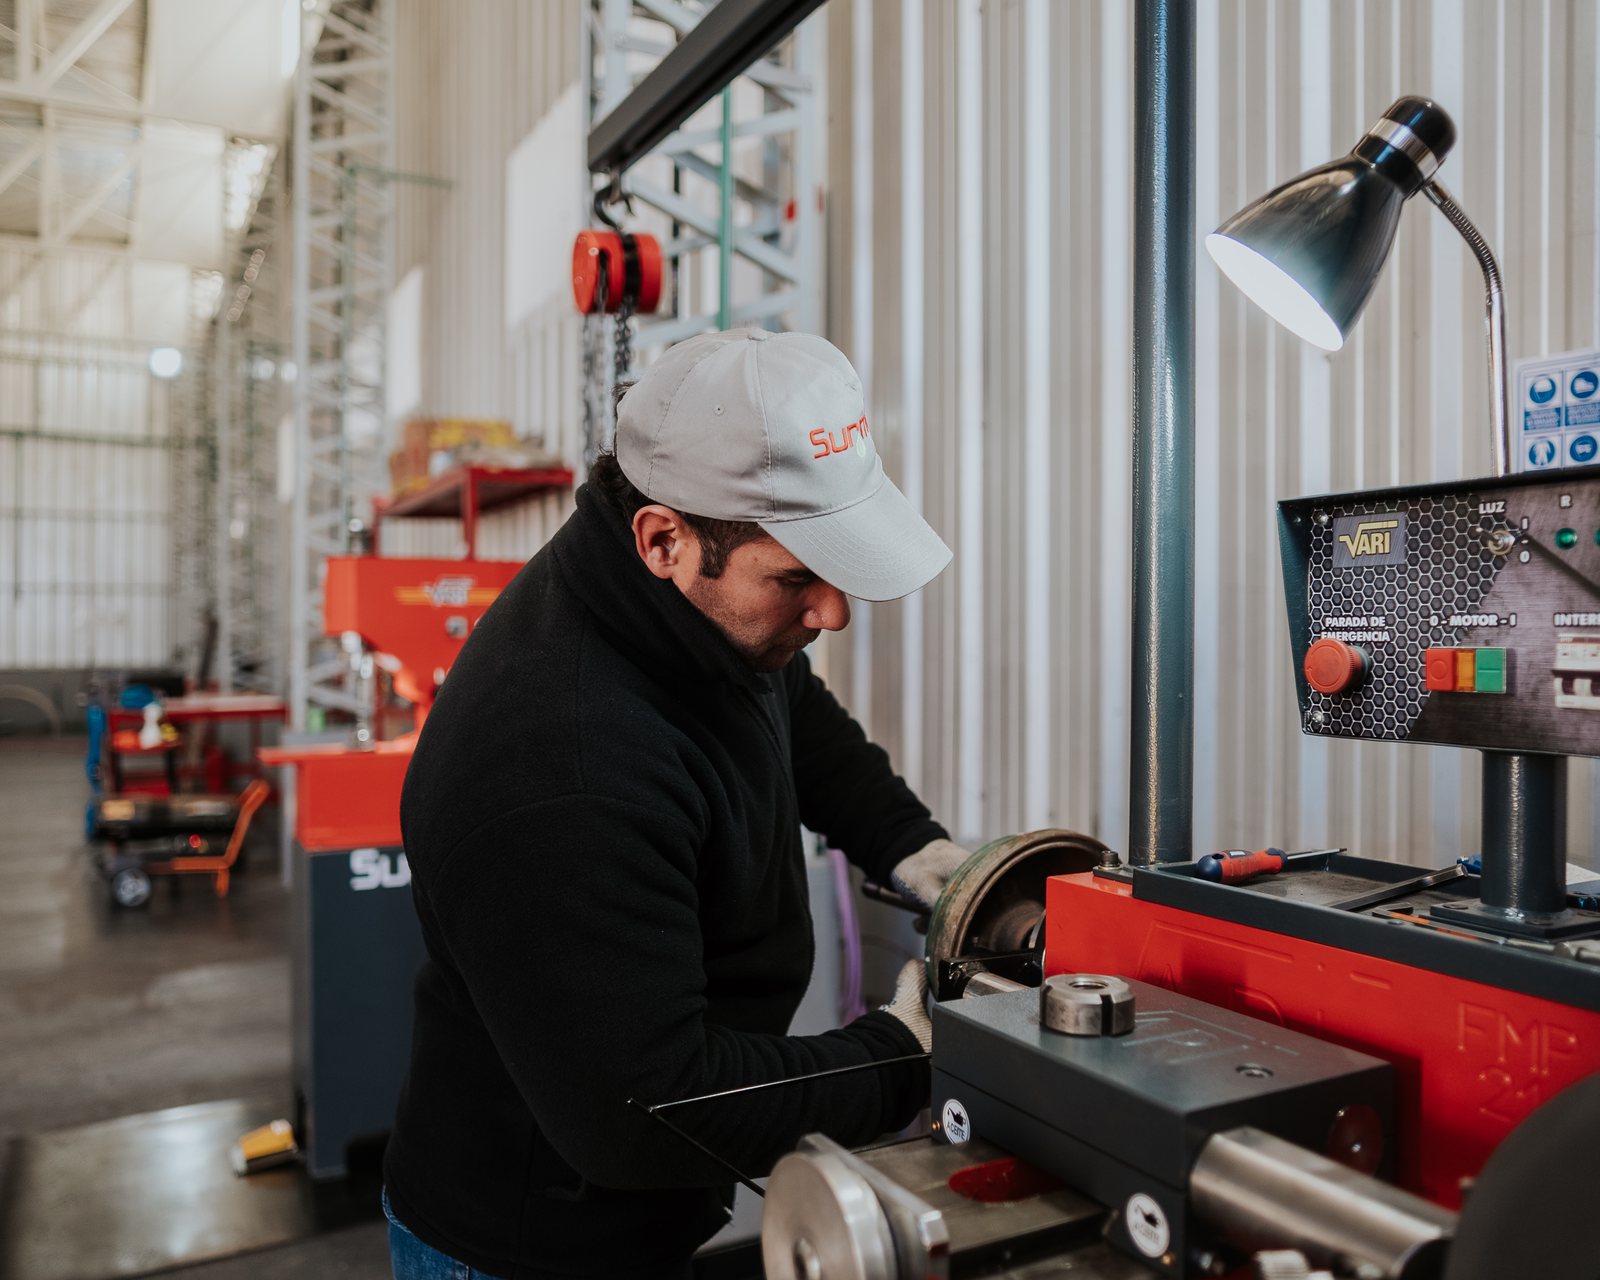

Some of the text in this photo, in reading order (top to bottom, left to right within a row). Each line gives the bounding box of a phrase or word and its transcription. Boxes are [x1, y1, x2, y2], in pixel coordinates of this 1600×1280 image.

[1560, 496, 1571, 507] R
[1479, 502, 1505, 514] LUZ
[1339, 520, 1398, 559] VARI
[1325, 616, 1386, 627] PARADA DE
[1450, 614, 1498, 626] MOTOR
[1321, 631, 1390, 642] EMERGENCIA
[1458, 1001, 1580, 1076] FMP
